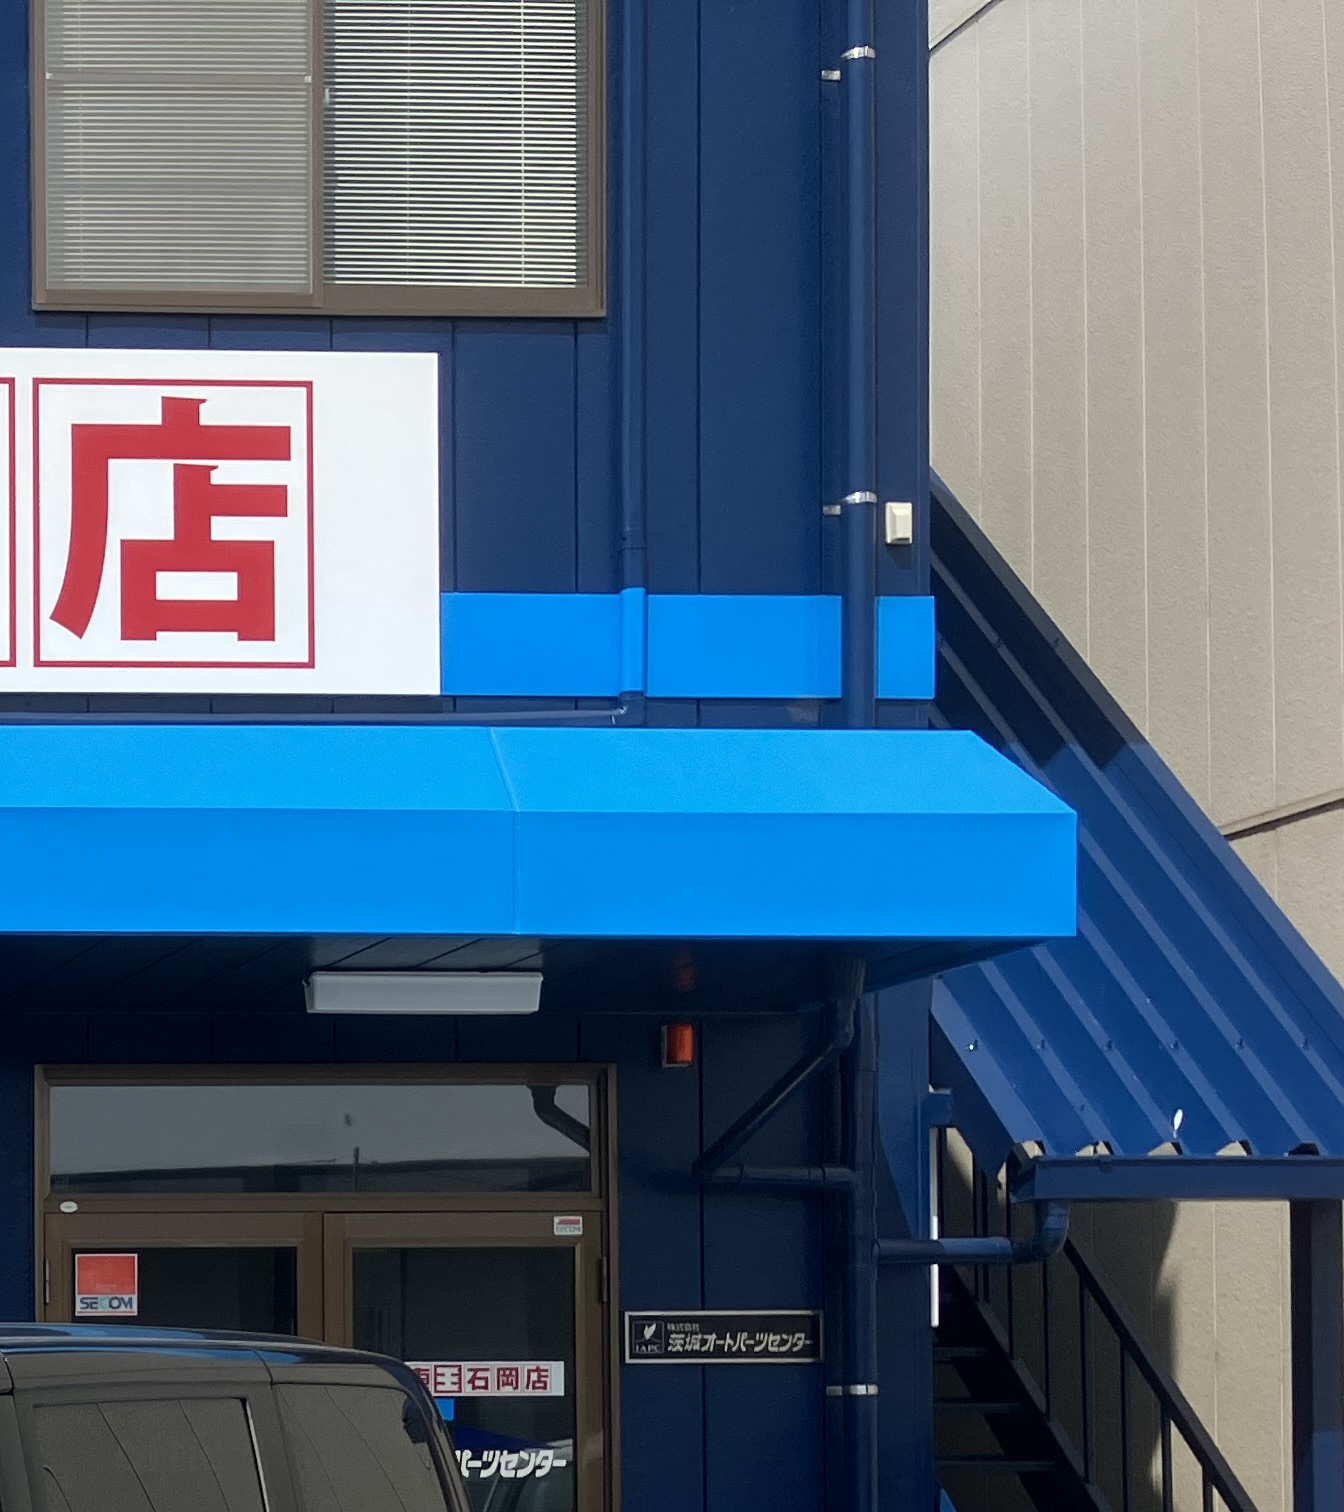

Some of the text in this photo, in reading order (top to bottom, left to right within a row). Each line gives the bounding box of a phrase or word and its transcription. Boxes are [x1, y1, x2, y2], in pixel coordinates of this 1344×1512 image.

[667, 1332, 812, 1352] 茨城オートパーツセンター
